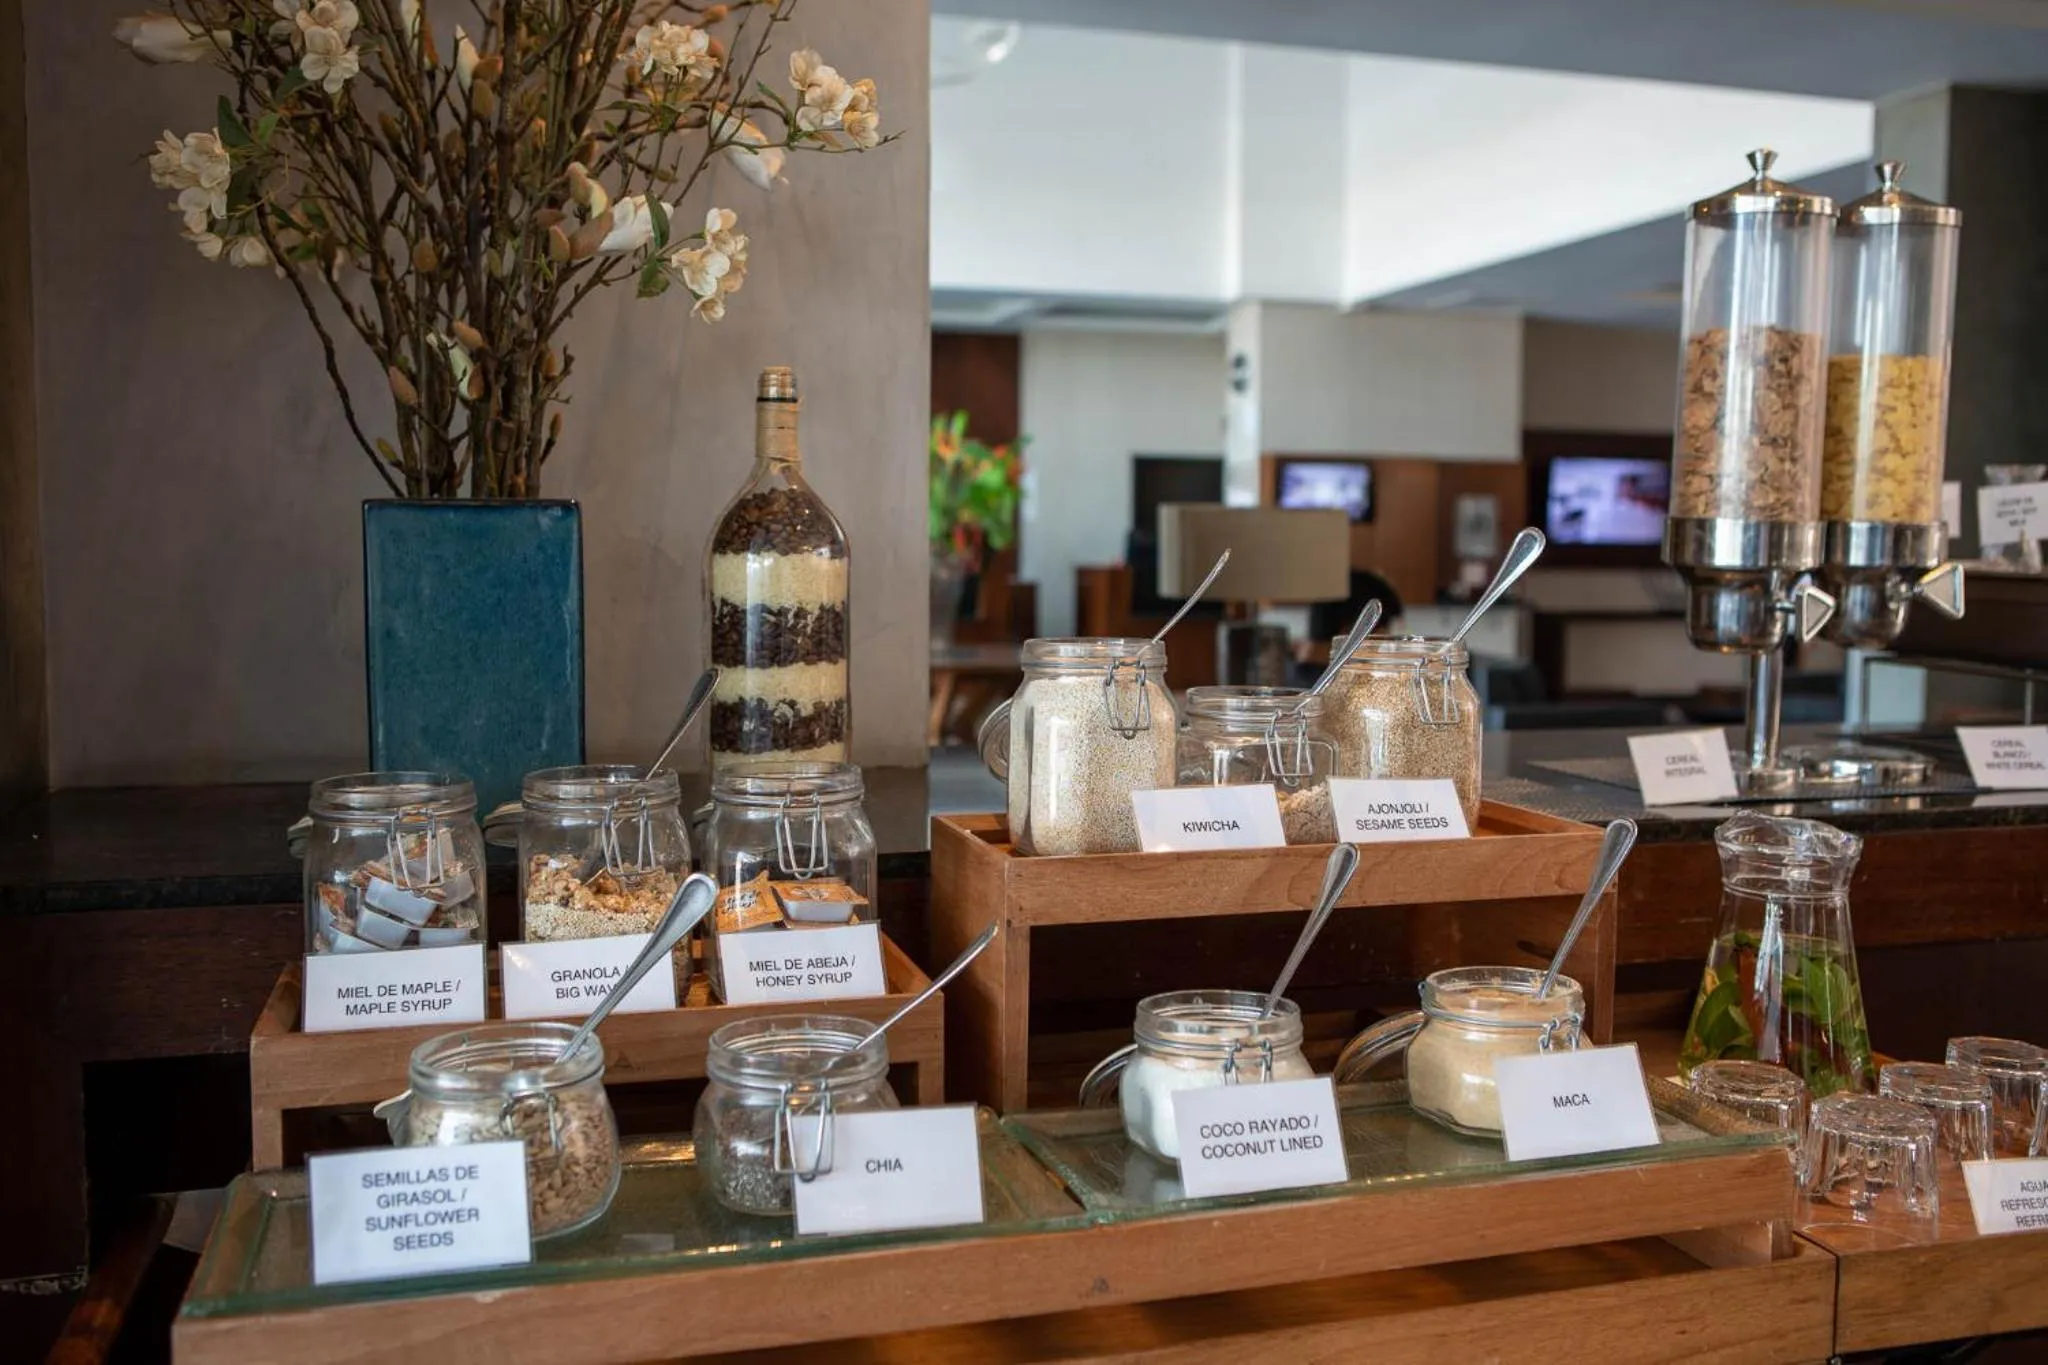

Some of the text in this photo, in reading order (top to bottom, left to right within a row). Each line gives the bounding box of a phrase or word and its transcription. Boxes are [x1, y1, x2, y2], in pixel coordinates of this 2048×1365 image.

[1368, 803, 1423, 814] AJONJOLI
[1182, 820, 1241, 832] KIWICHA
[1356, 817, 1449, 831] SESAME SEEDS
[749, 960, 781, 972] MIEL
[784, 958, 803, 970] DE
[806, 956, 849, 969] ABEJA
[551, 966, 621, 982] GRANOLA
[756, 971, 853, 988] HONEY SYRUP
[337, 986, 372, 1000] MIEL
[377, 984, 398, 997] DE
[402, 980, 452, 996] MAPLE
[556, 986, 581, 999] BIG
[345, 998, 452, 1016] MAPLE SYRUP
[1553, 1093, 1591, 1109] MACA
[1200, 1122, 1245, 1139] COCO
[1248, 1115, 1311, 1135] RAYADO
[1201, 1135, 1324, 1159] COCONUT LINED
[865, 1158, 904, 1174] CHIA
[362, 1164, 480, 1189] SEMILLAS DE
[376, 1188, 456, 1209] GIRASOL
[365, 1207, 480, 1232] SUNFLOWER
[393, 1231, 455, 1251] SEEDS
